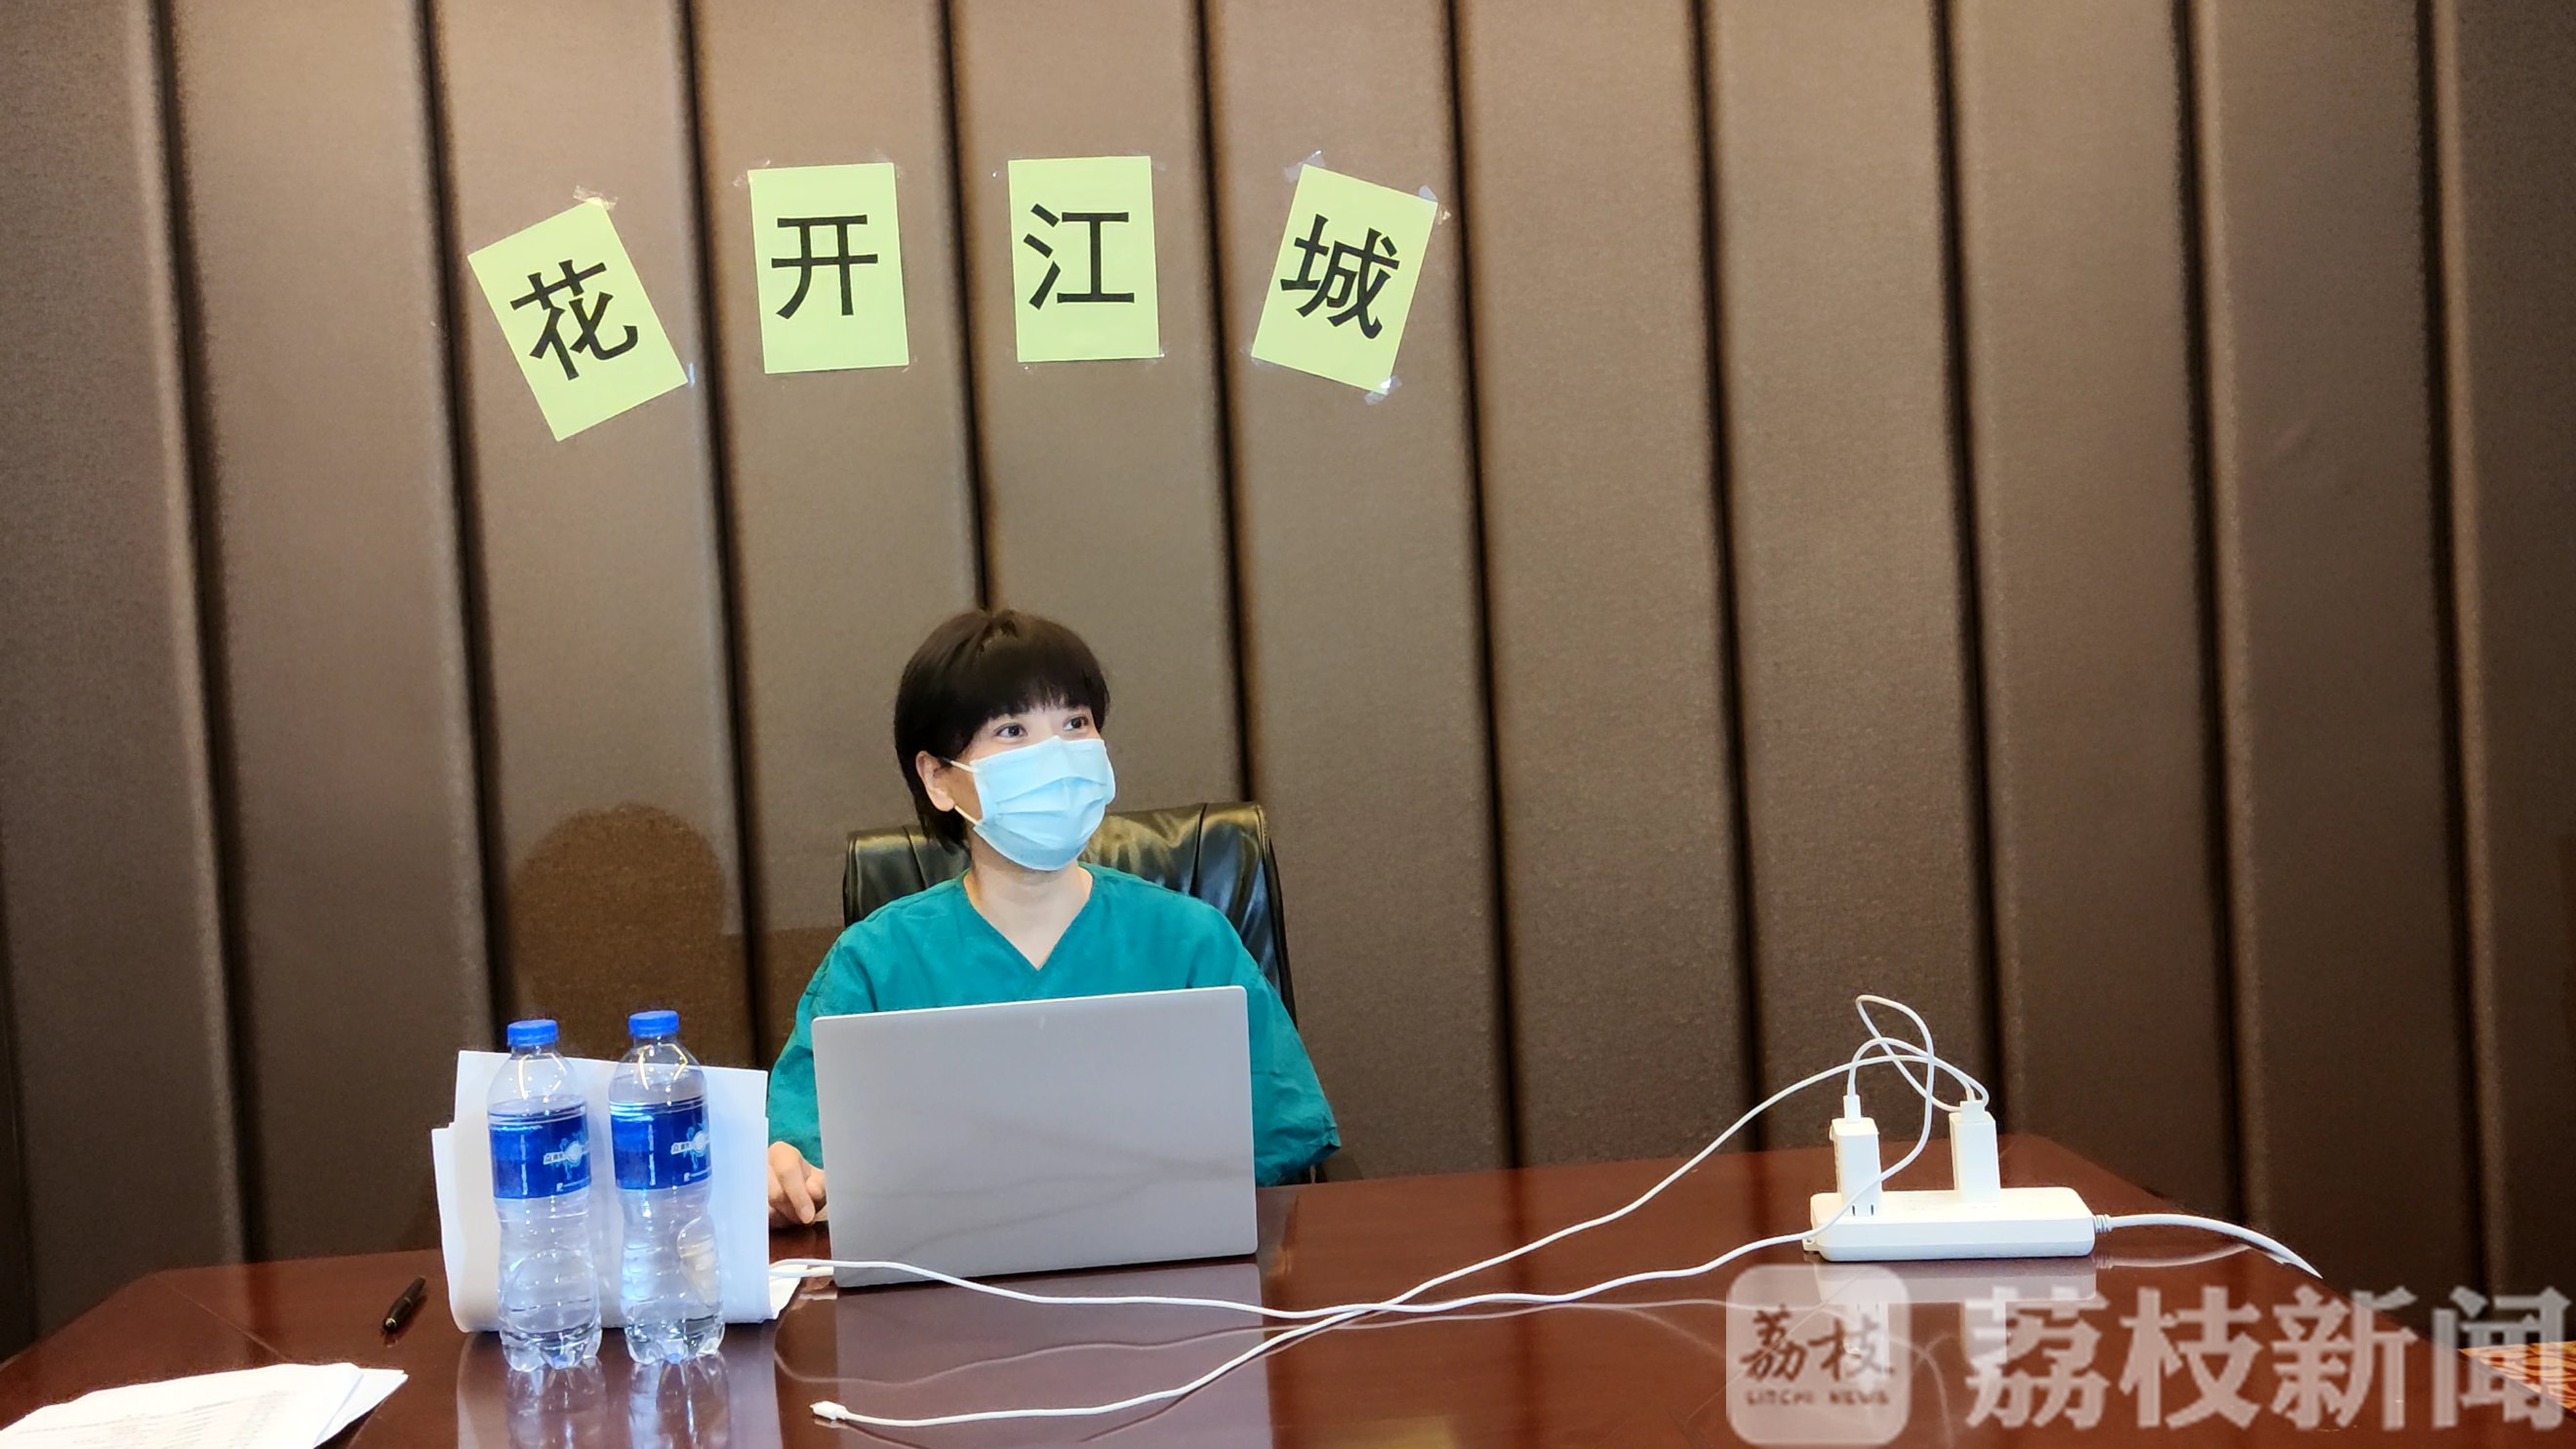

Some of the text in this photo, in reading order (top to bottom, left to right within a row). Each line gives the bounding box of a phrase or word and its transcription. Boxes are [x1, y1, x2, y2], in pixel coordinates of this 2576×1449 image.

[508, 203, 1401, 382] 花 开 江 城
